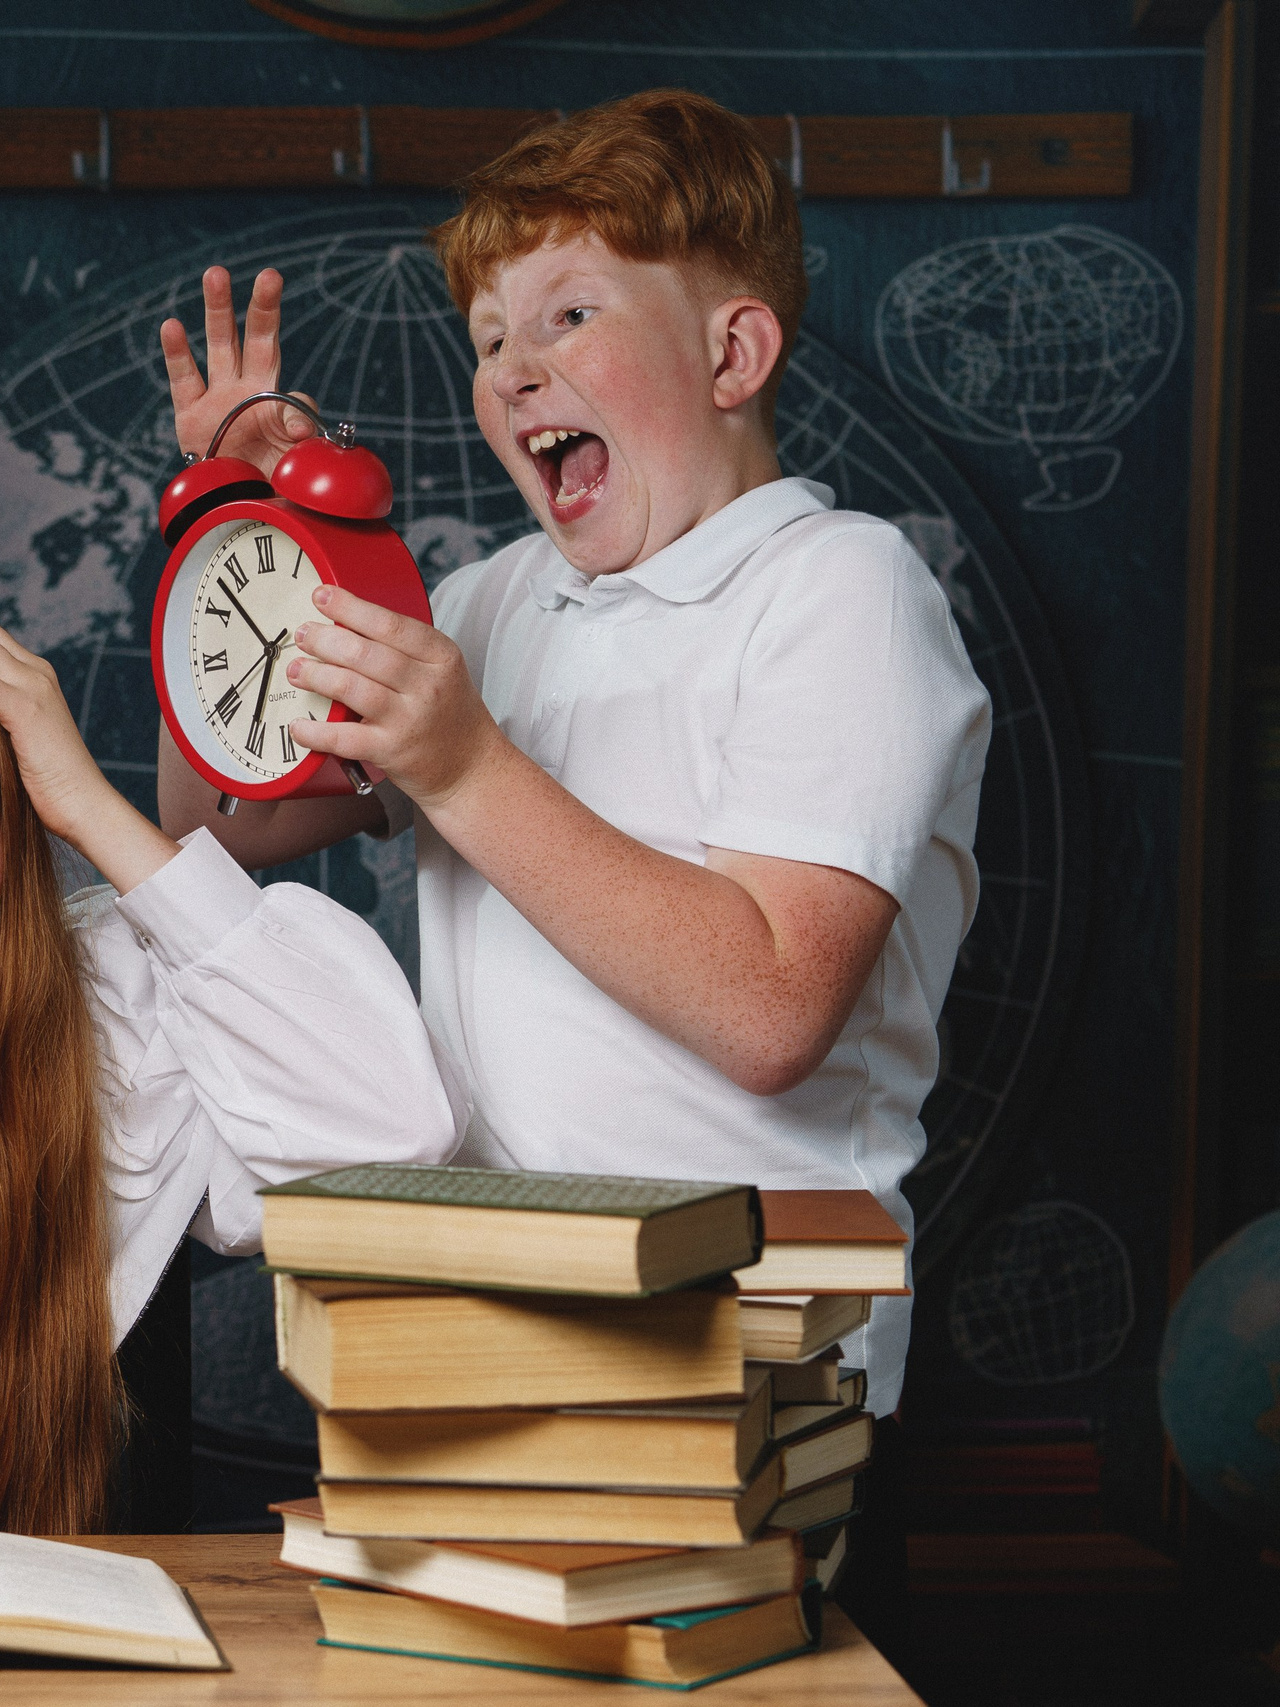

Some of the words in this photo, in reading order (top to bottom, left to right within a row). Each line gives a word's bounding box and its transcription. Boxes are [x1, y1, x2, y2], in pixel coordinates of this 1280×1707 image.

[254, 534, 276, 574] XII
[223, 552, 250, 593] XI
[205, 596, 231, 628] X
[202, 649, 229, 674] IX
[268, 690, 297, 702] QUARTZ
[244, 715, 266, 759] VII
